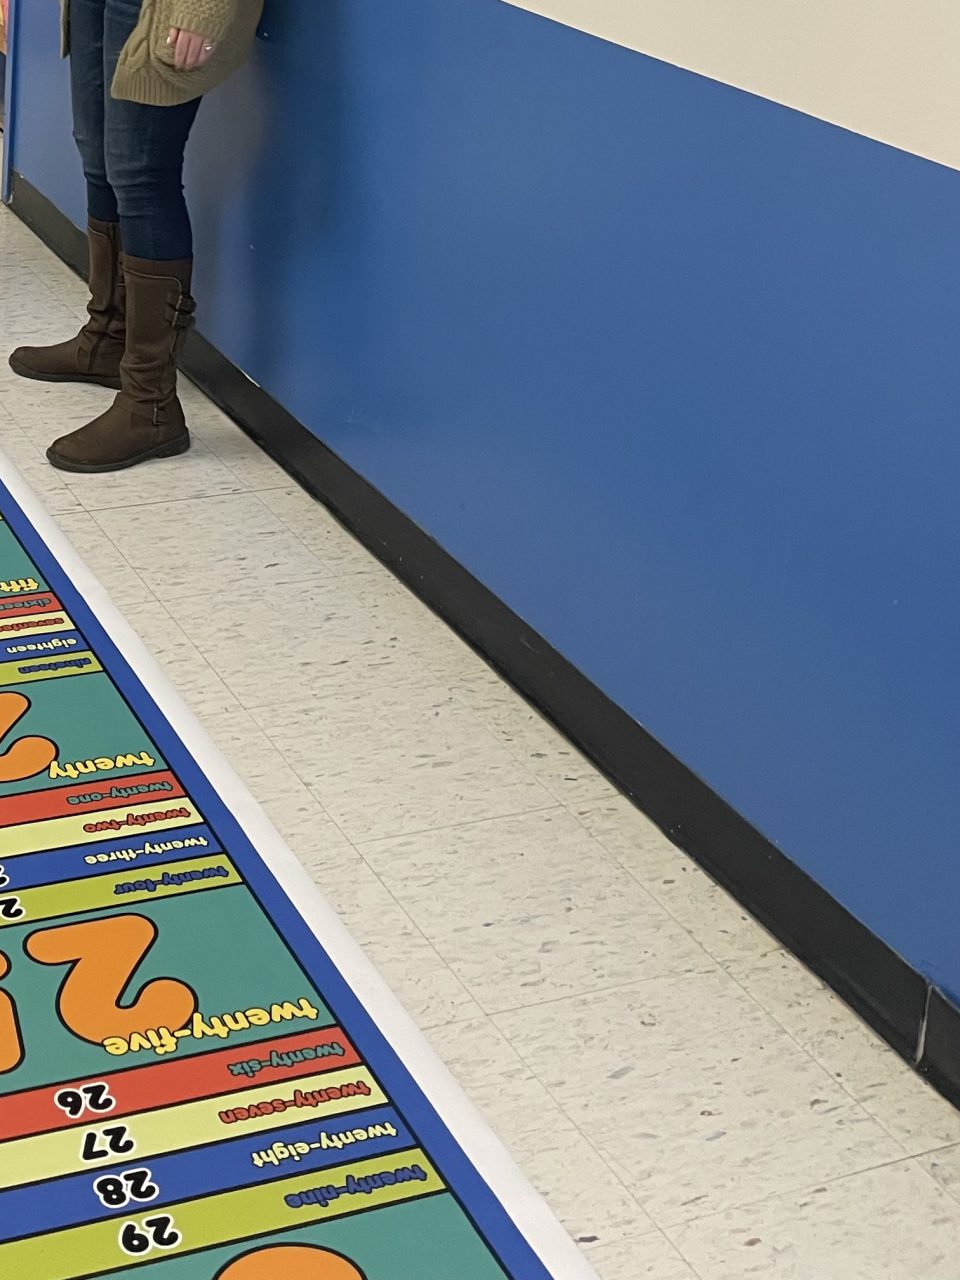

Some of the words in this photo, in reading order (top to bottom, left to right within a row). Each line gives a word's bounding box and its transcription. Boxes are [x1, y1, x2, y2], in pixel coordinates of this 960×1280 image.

[6, 637, 77, 654] eighteen
[18, 657, 92, 674] nineteen
[47, 750, 156, 780] twenty
[66, 778, 174, 807] twenty-one
[82, 804, 192, 835] twenty-two
[83, 834, 210, 866] twenty-three
[113, 864, 230, 896] twenty-four
[103, 997, 320, 1056] twenty-five
[228, 1042, 345, 1078] twenty-six
[54, 1081, 118, 1119] 26
[217, 1080, 371, 1124] twenty-seven
[80, 1124, 136, 1163] 27
[252, 1120, 398, 1169] twenty-eight
[94, 1168, 160, 1208] 28
[284, 1164, 428, 1209] twenty-nine
[117, 1214, 183, 1256] 29
